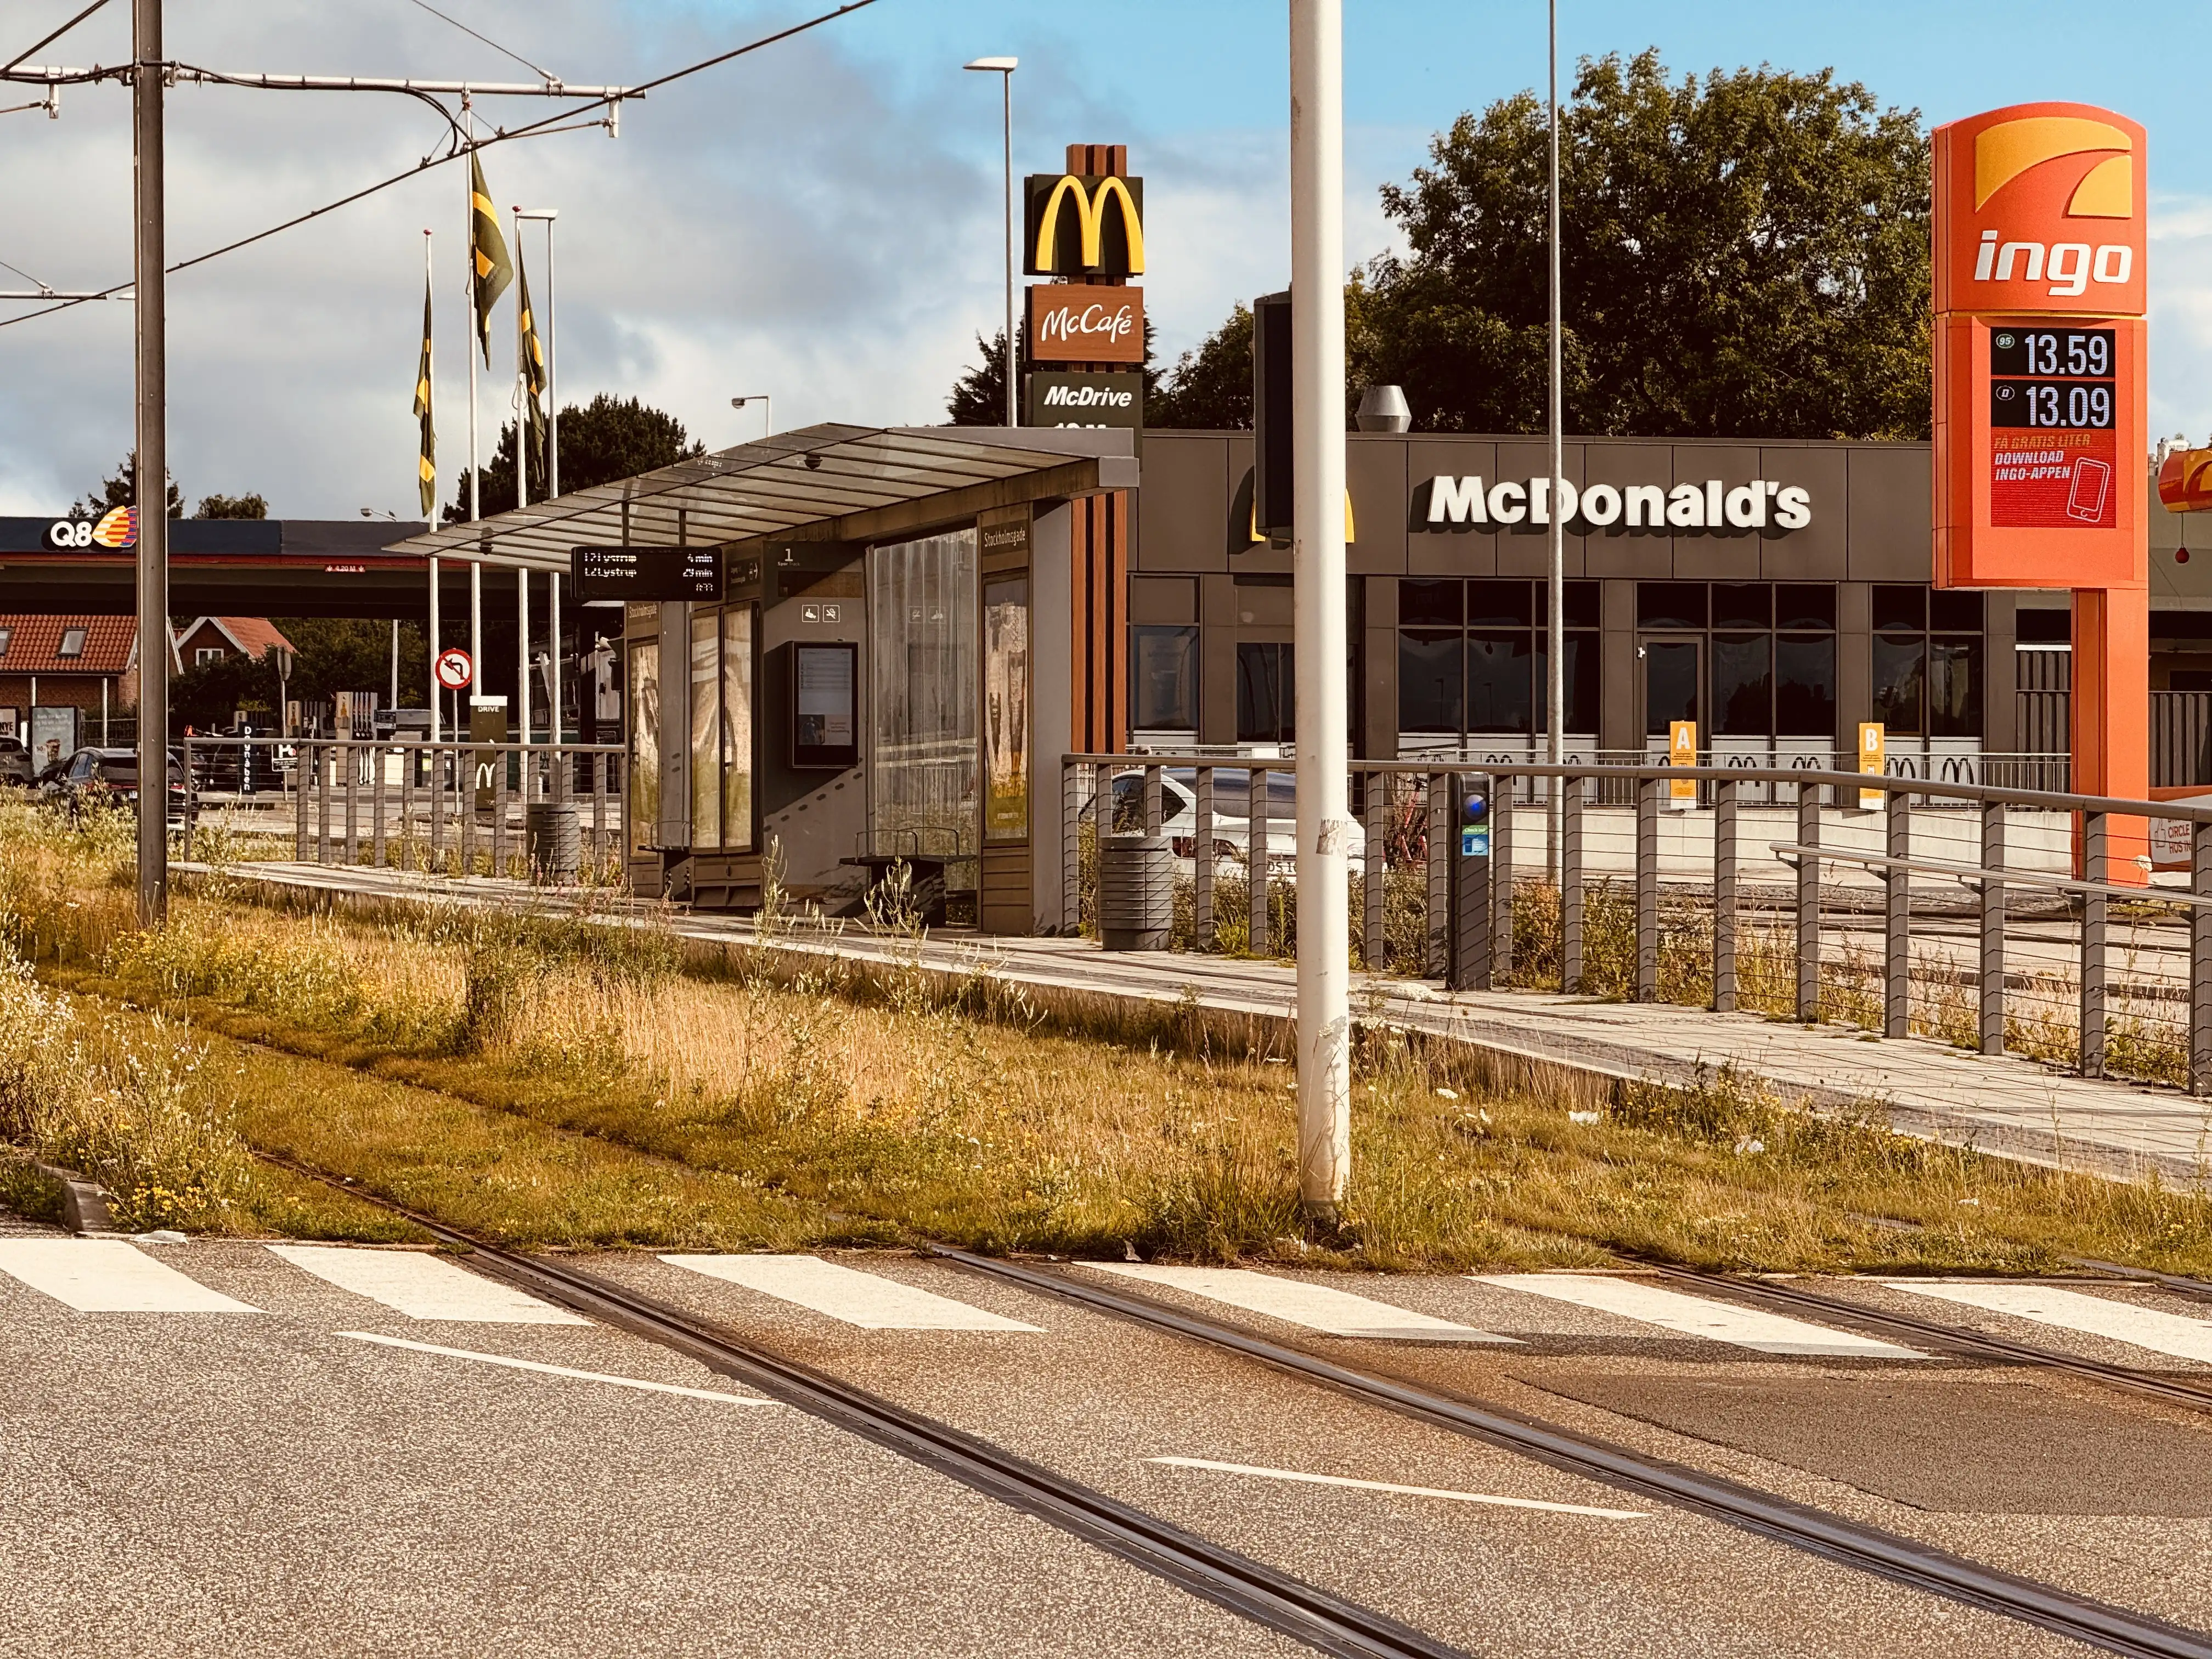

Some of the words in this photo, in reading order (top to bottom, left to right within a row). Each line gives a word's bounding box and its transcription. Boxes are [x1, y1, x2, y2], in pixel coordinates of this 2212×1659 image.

[1974, 230, 2132, 296] ingo
[1041, 304, 1133, 343] McCafé
[1999, 337, 2011, 345] 95
[2024, 334, 2108, 375] 13.59
[1043, 386, 1132, 407] McDrive
[2026, 386, 2109, 427] 13.09
[2011, 436, 2056, 449] GRATIS
[2058, 434, 2091, 448] LITER
[1994, 450, 2064, 465] DOWNLOAD
[1995, 466, 2071, 481] INGO-APPEN
[1426, 475, 1812, 529] McDonald's
[50, 521, 92, 548] Q8
[984, 527, 1026, 548] Stockholmsgade
[695, 554, 713, 562] min
[785, 548, 793, 562] 1
[598, 567, 637, 578] Lystrup
[695, 569, 713, 577] min
[1676, 727, 1691, 749] A
[1865, 729, 1878, 751] B
[2168, 824, 2191, 838] CIRCLE
